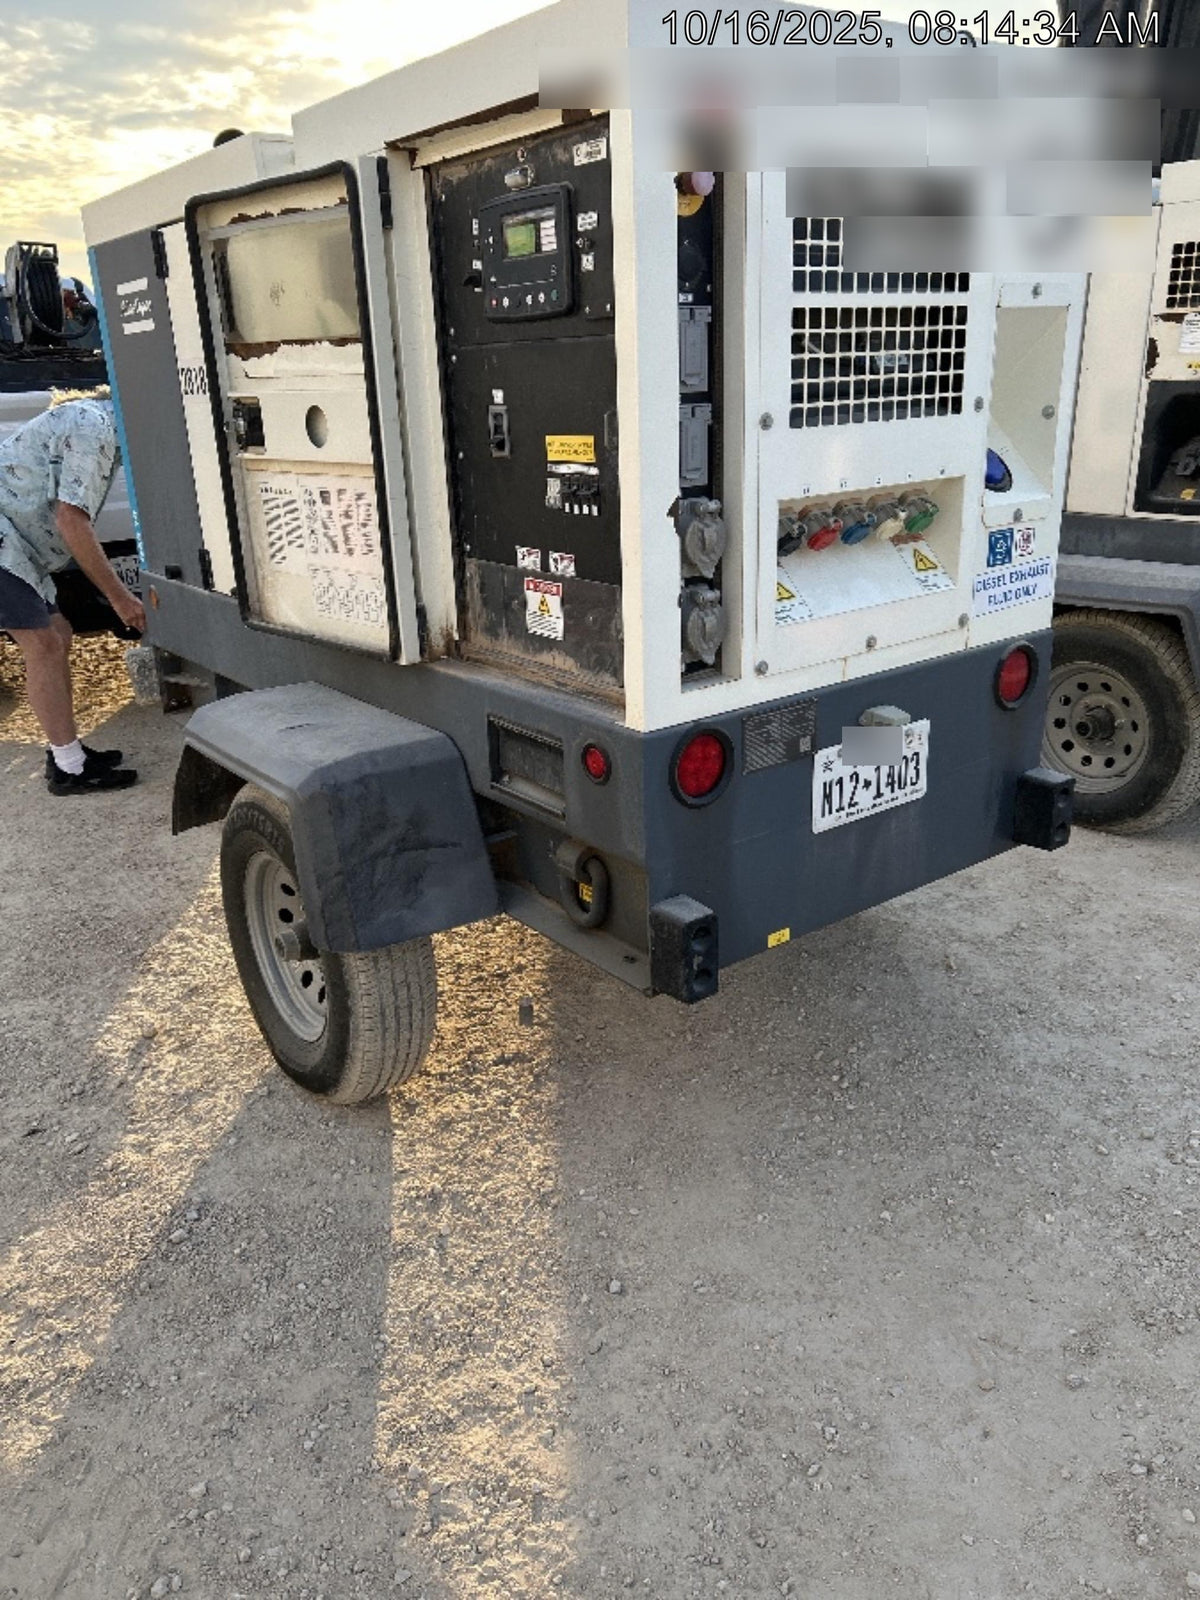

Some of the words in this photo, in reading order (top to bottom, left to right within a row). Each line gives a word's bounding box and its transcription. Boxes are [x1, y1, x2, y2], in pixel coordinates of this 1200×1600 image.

[976, 574, 1007, 592] DIESEL
[1009, 563, 1050, 583] EXHAUST
[1015, 583, 1038, 600] ONLY
